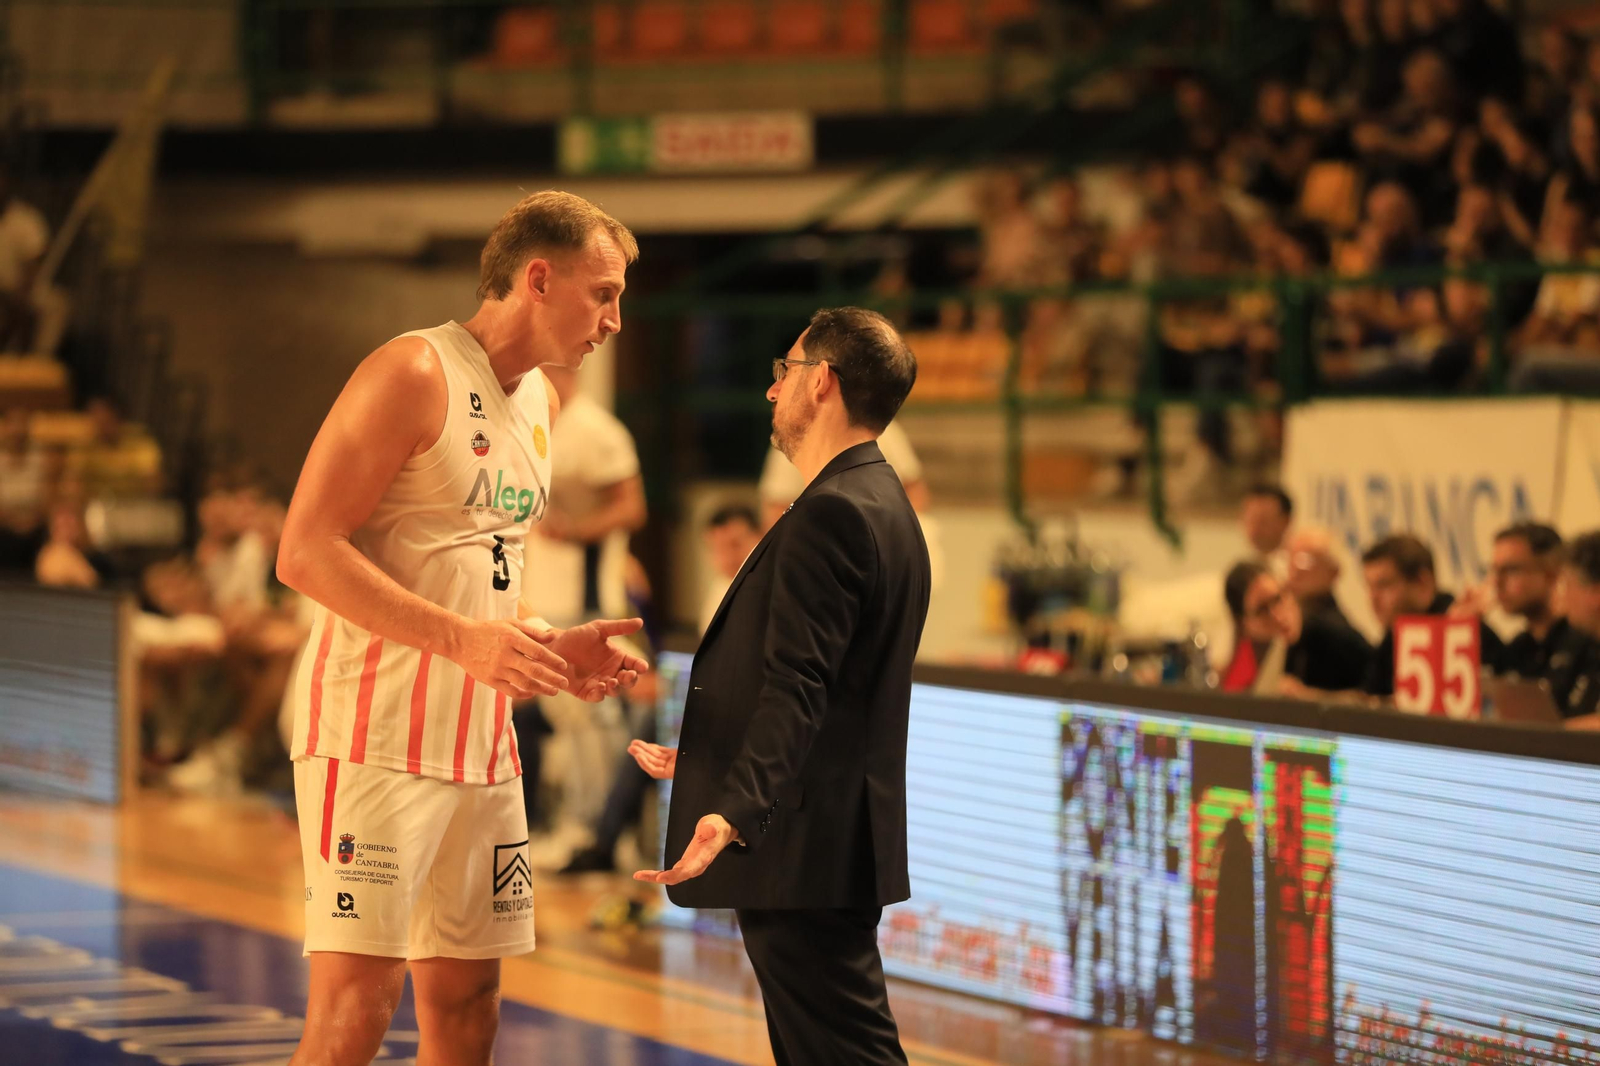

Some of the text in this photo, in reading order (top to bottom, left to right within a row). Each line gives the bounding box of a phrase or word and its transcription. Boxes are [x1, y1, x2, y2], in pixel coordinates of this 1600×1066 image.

[488, 508, 513, 520] derecho
[1395, 623, 1477, 720] 55
[356, 843, 398, 853] GOBIERNO
[355, 859, 400, 870] CANTABRIA
[369, 878, 394, 886] DEPORTE
[493, 900, 511, 913] RENTAS
[512, 899, 516, 912] Y
